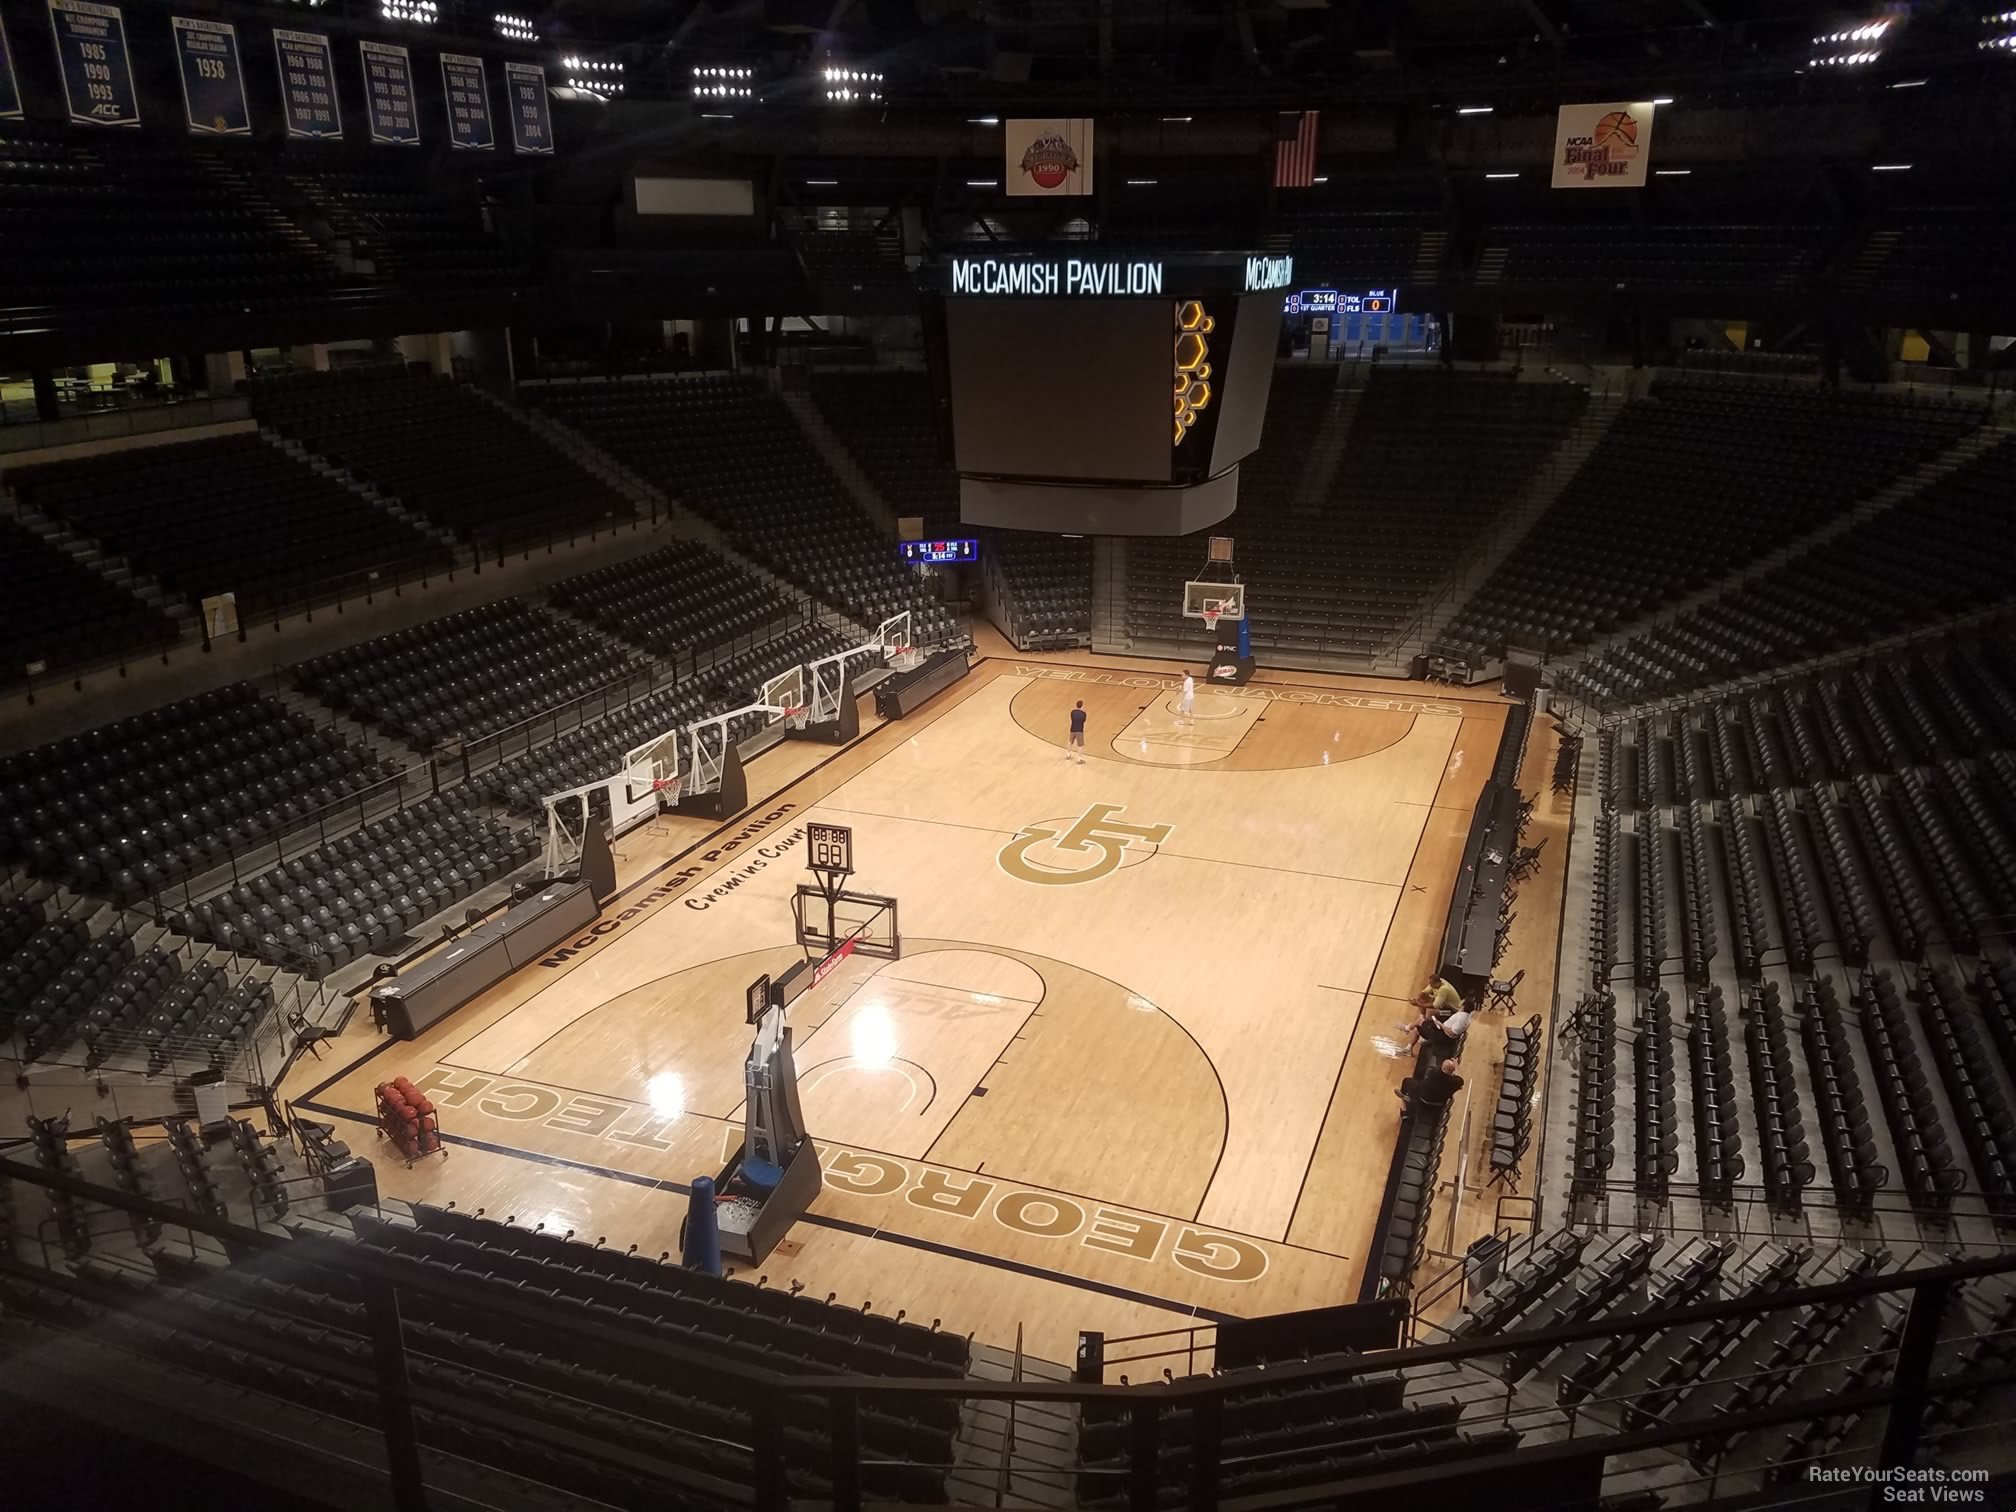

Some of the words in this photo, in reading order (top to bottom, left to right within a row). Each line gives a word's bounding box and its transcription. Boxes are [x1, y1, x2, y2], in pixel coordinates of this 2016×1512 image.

[80, 42, 105, 60] 1985
[84, 63, 110, 80] 1990
[196, 58, 225, 80] 1938
[88, 83, 113, 100] 1993
[91, 104, 120, 115] ACC
[1567, 137, 1593, 145] NCAA
[1563, 145, 1609, 165] Final
[1038, 164, 1060, 172] 1990
[1584, 160, 1629, 180] Four
[1067, 259, 1162, 294] PAVILION
[1313, 293, 1335, 303] 3:14
[1371, 300, 1380, 311] 0
[1015, 666, 1205, 692] YELLOW
[1213, 686, 1463, 716] JACKETS
[684, 858, 768, 911] Cremins
[758, 826, 808, 860] Court
[538, 865, 704, 968] McCamish
[700, 803, 797, 862] Pavilion
[411, 1067, 676, 1152] TECH
